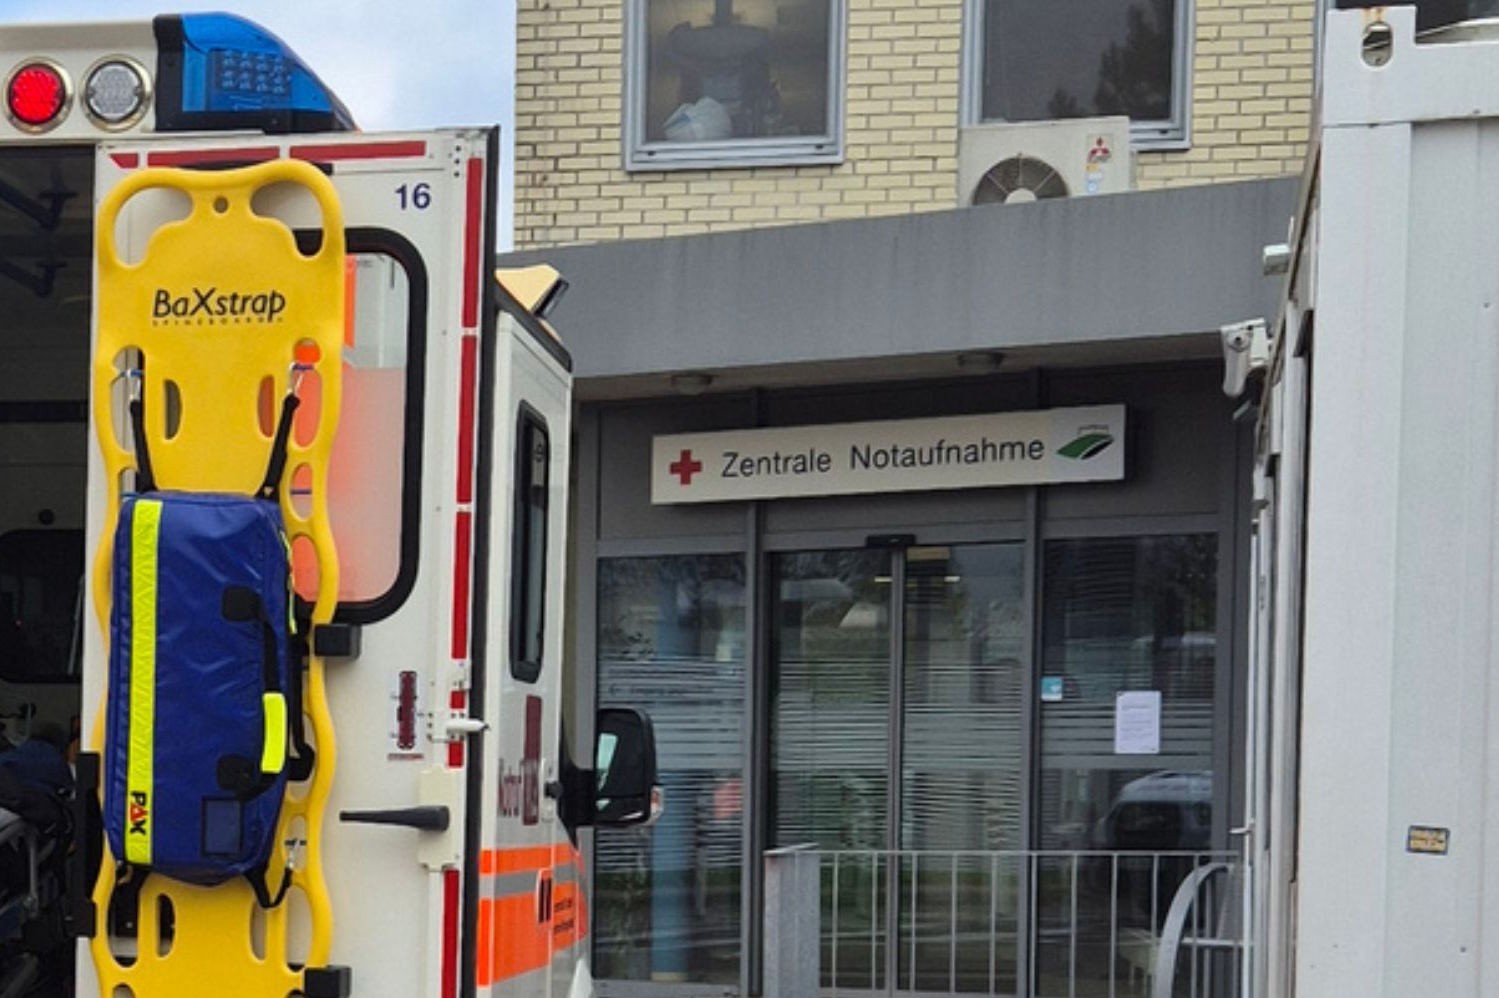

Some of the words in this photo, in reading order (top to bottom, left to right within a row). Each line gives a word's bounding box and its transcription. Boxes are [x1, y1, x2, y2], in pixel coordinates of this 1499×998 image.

[395, 183, 432, 211] 16
[153, 287, 286, 322] BaXstrap
[722, 447, 832, 478] Zentrale
[851, 437, 1045, 470] Notaufnahme
[130, 790, 148, 836] PAX
